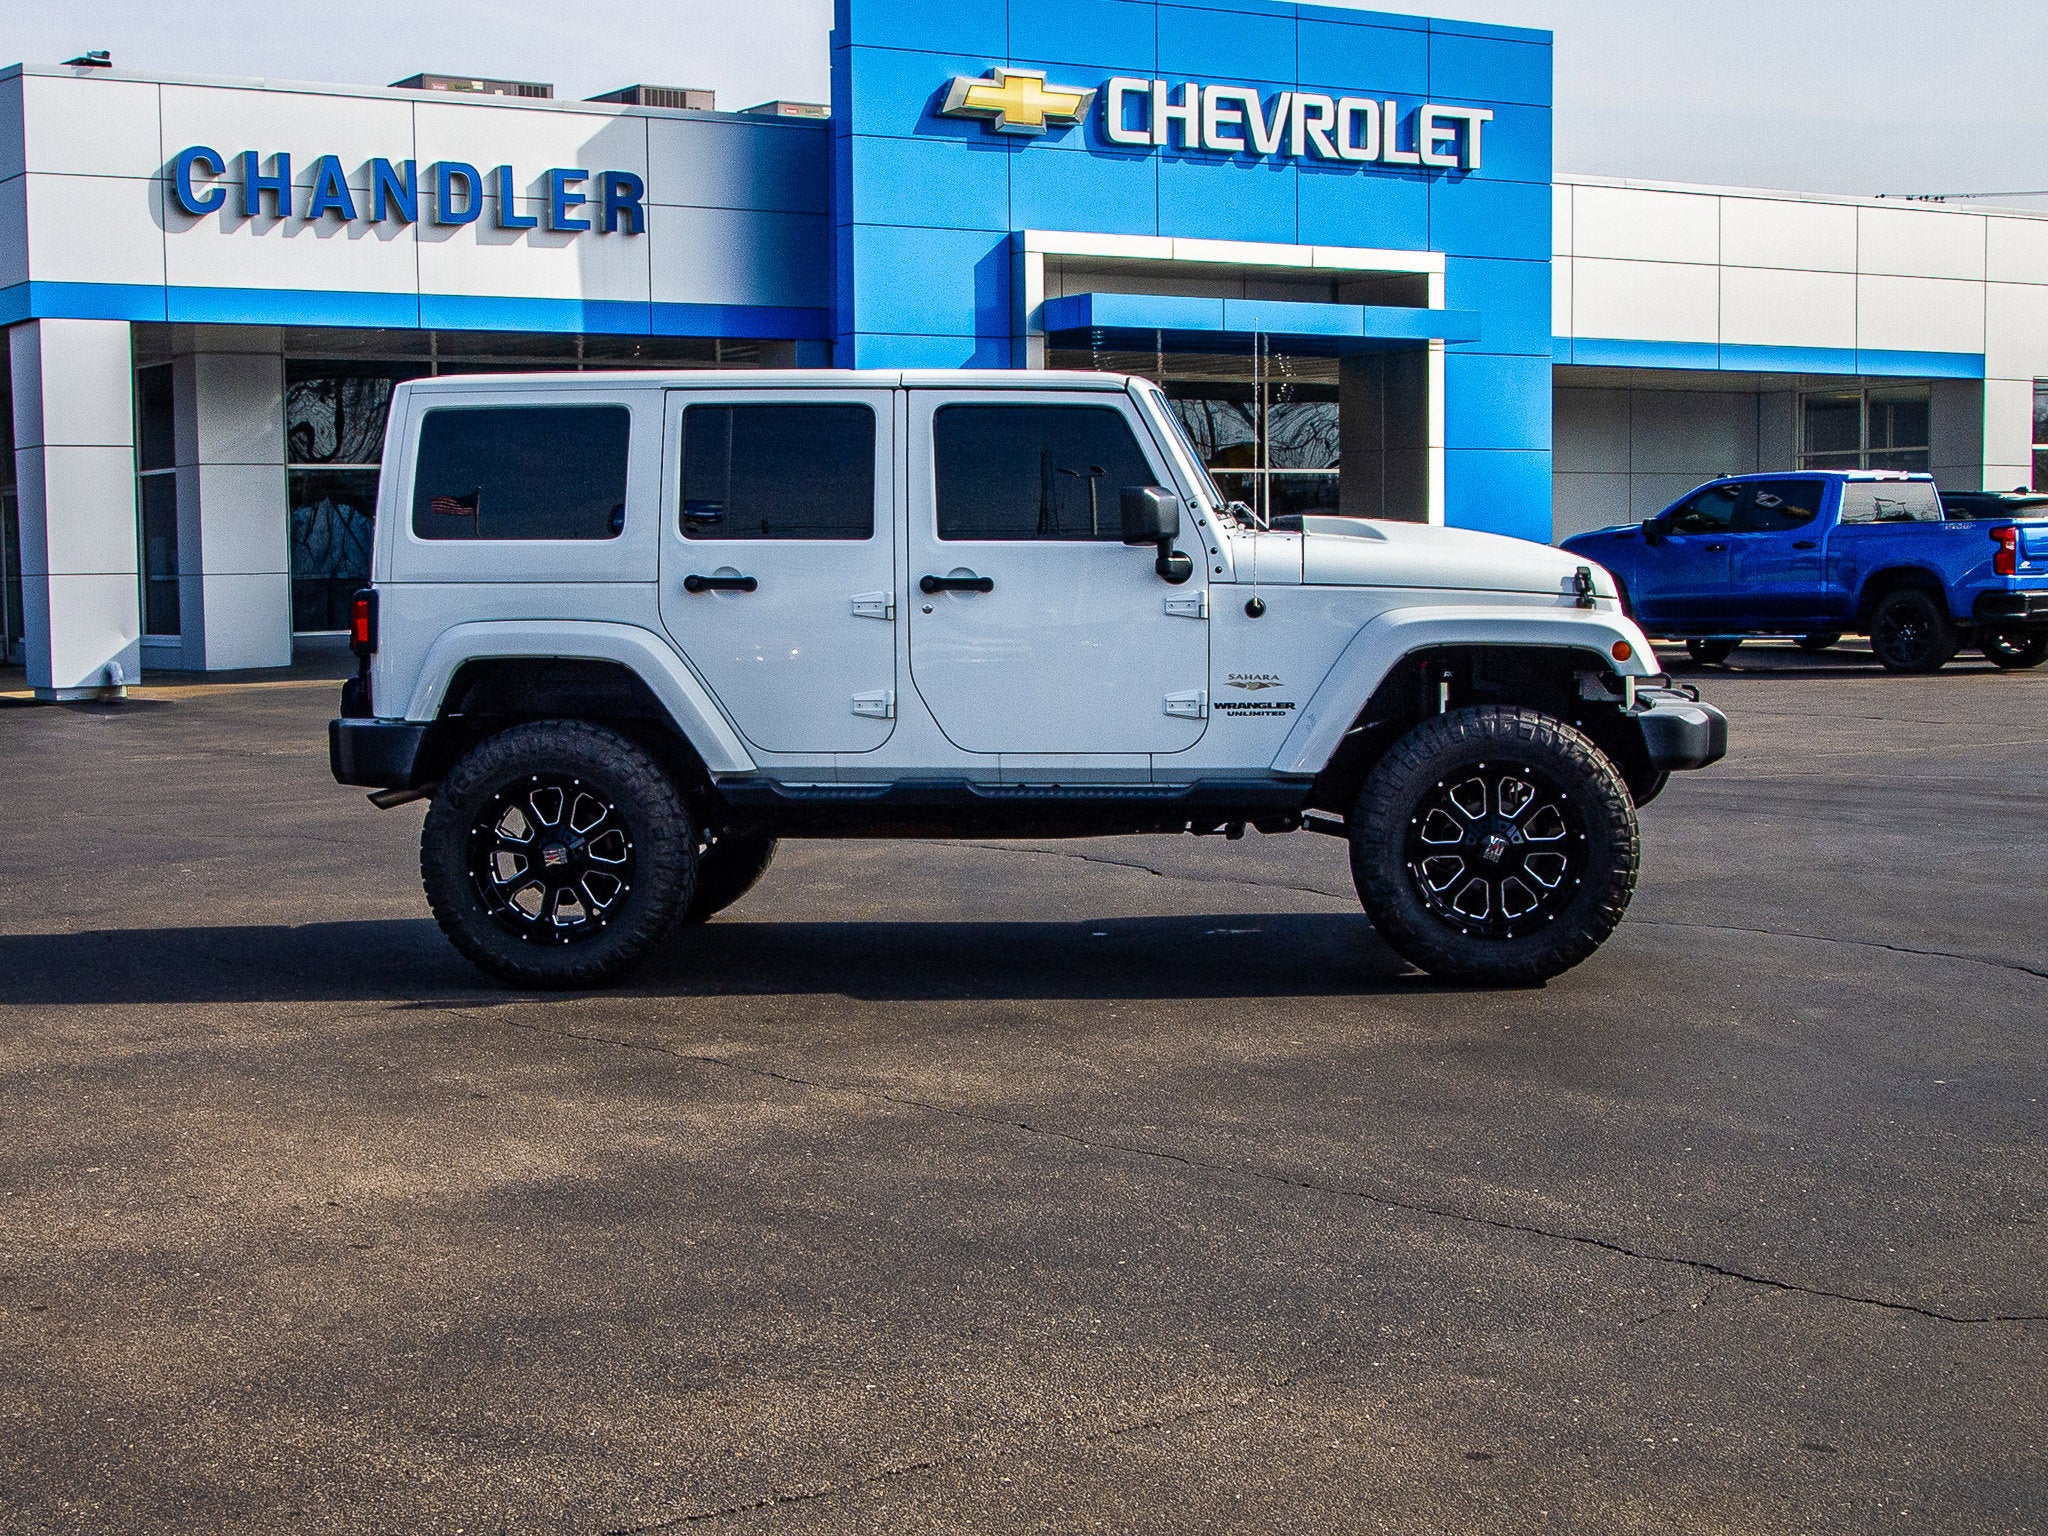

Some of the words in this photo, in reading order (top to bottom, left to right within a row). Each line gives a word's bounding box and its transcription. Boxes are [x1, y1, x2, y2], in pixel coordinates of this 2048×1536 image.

[1104, 76, 1494, 171] CHEVROLET
[173, 145, 647, 235] CHANDLER
[1228, 673, 1280, 681] SAHARA
[1213, 702, 1296, 710] WRANGLER
